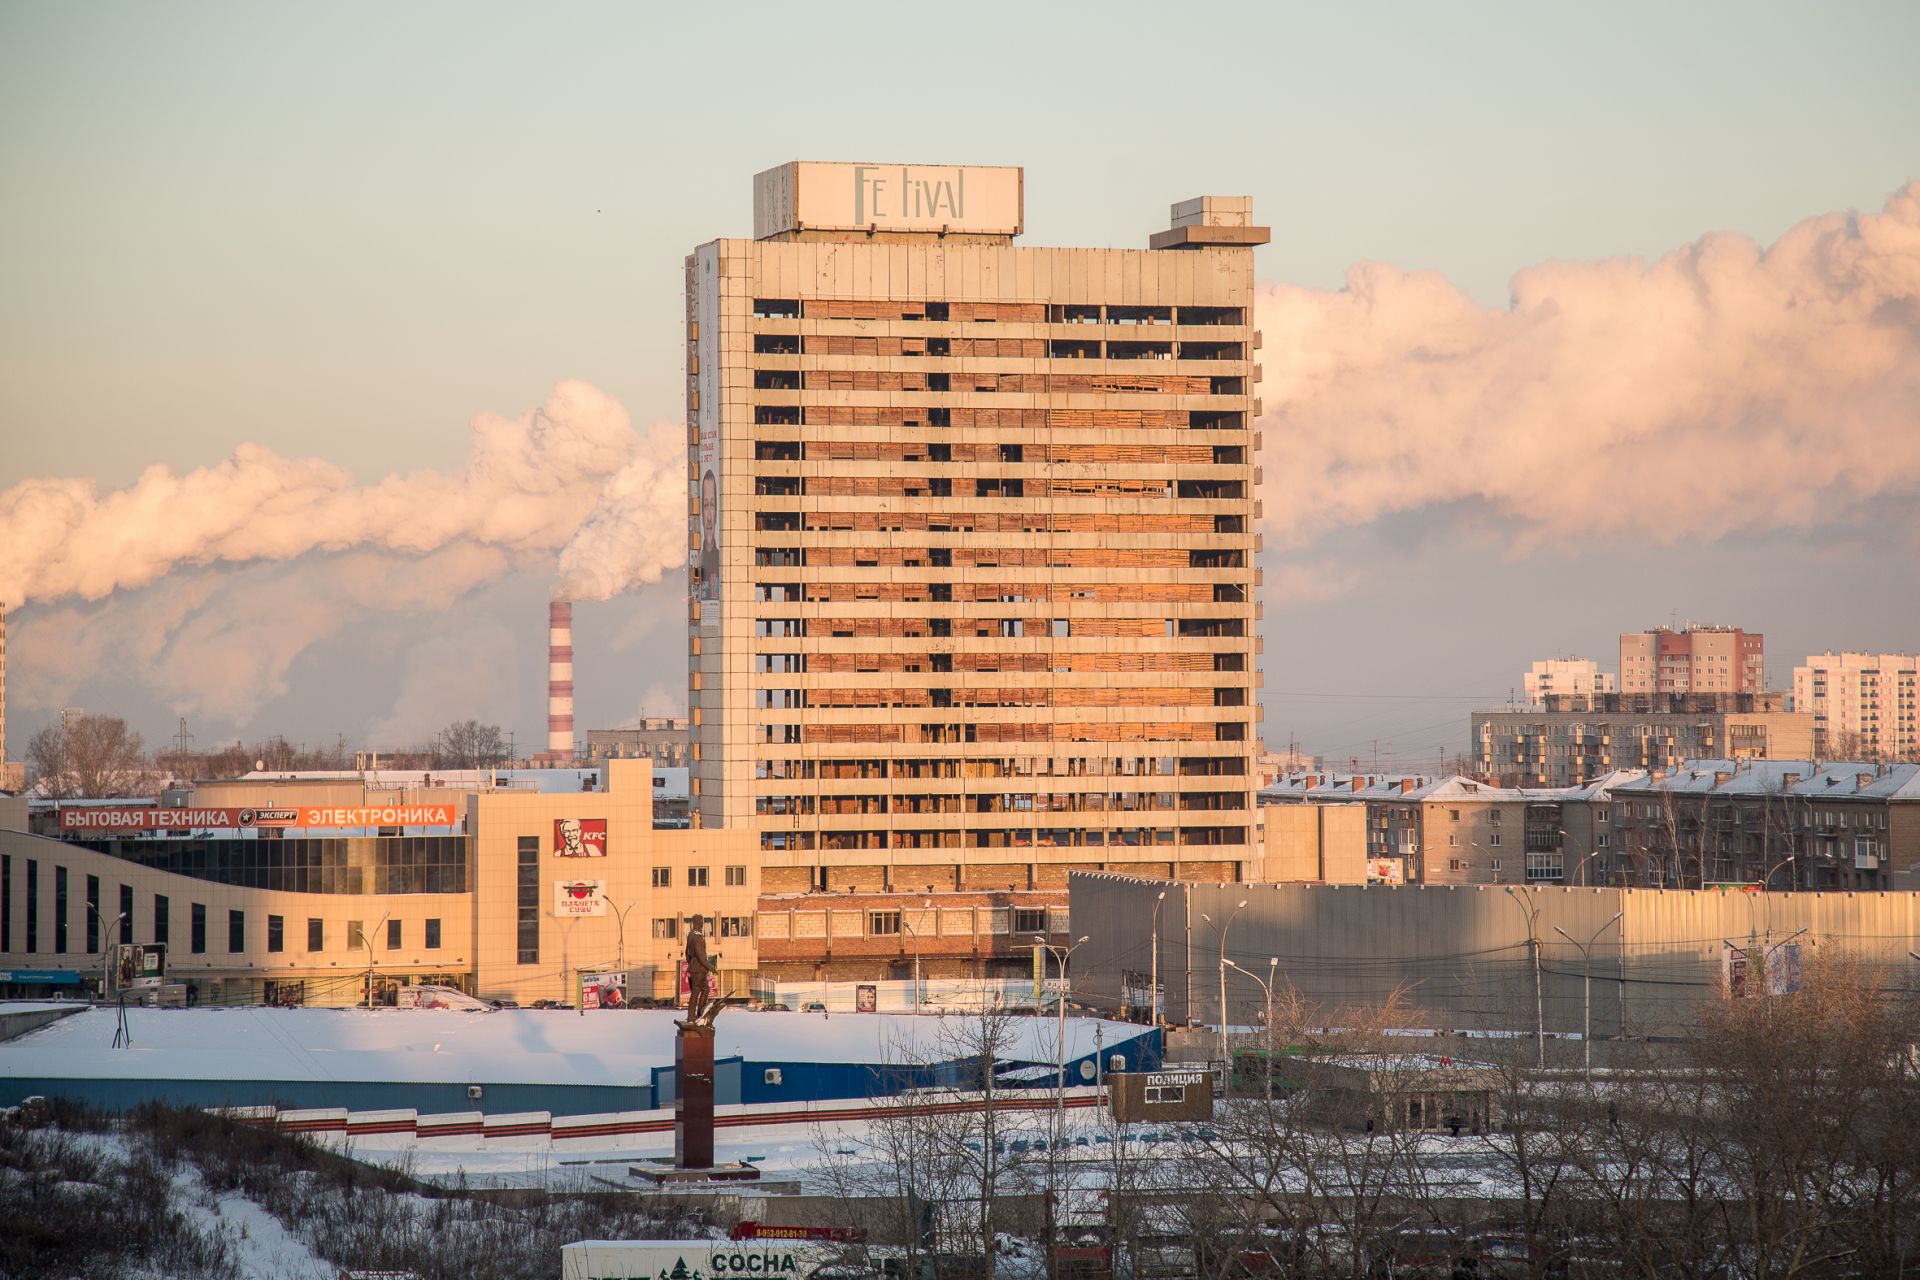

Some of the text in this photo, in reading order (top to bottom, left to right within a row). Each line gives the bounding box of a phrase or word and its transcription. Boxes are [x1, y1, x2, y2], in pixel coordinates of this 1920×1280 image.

[65, 811, 229, 827] БЫТОВАЯ ТЕХНИКА
[258, 811, 295, 820] ЭКСПЕРТ
[307, 807, 448, 825] ЭЛЕКТРОНИКА
[1146, 1073, 1203, 1086] ПОЛИЦИЯ
[712, 1254, 796, 1271] СОСНА
